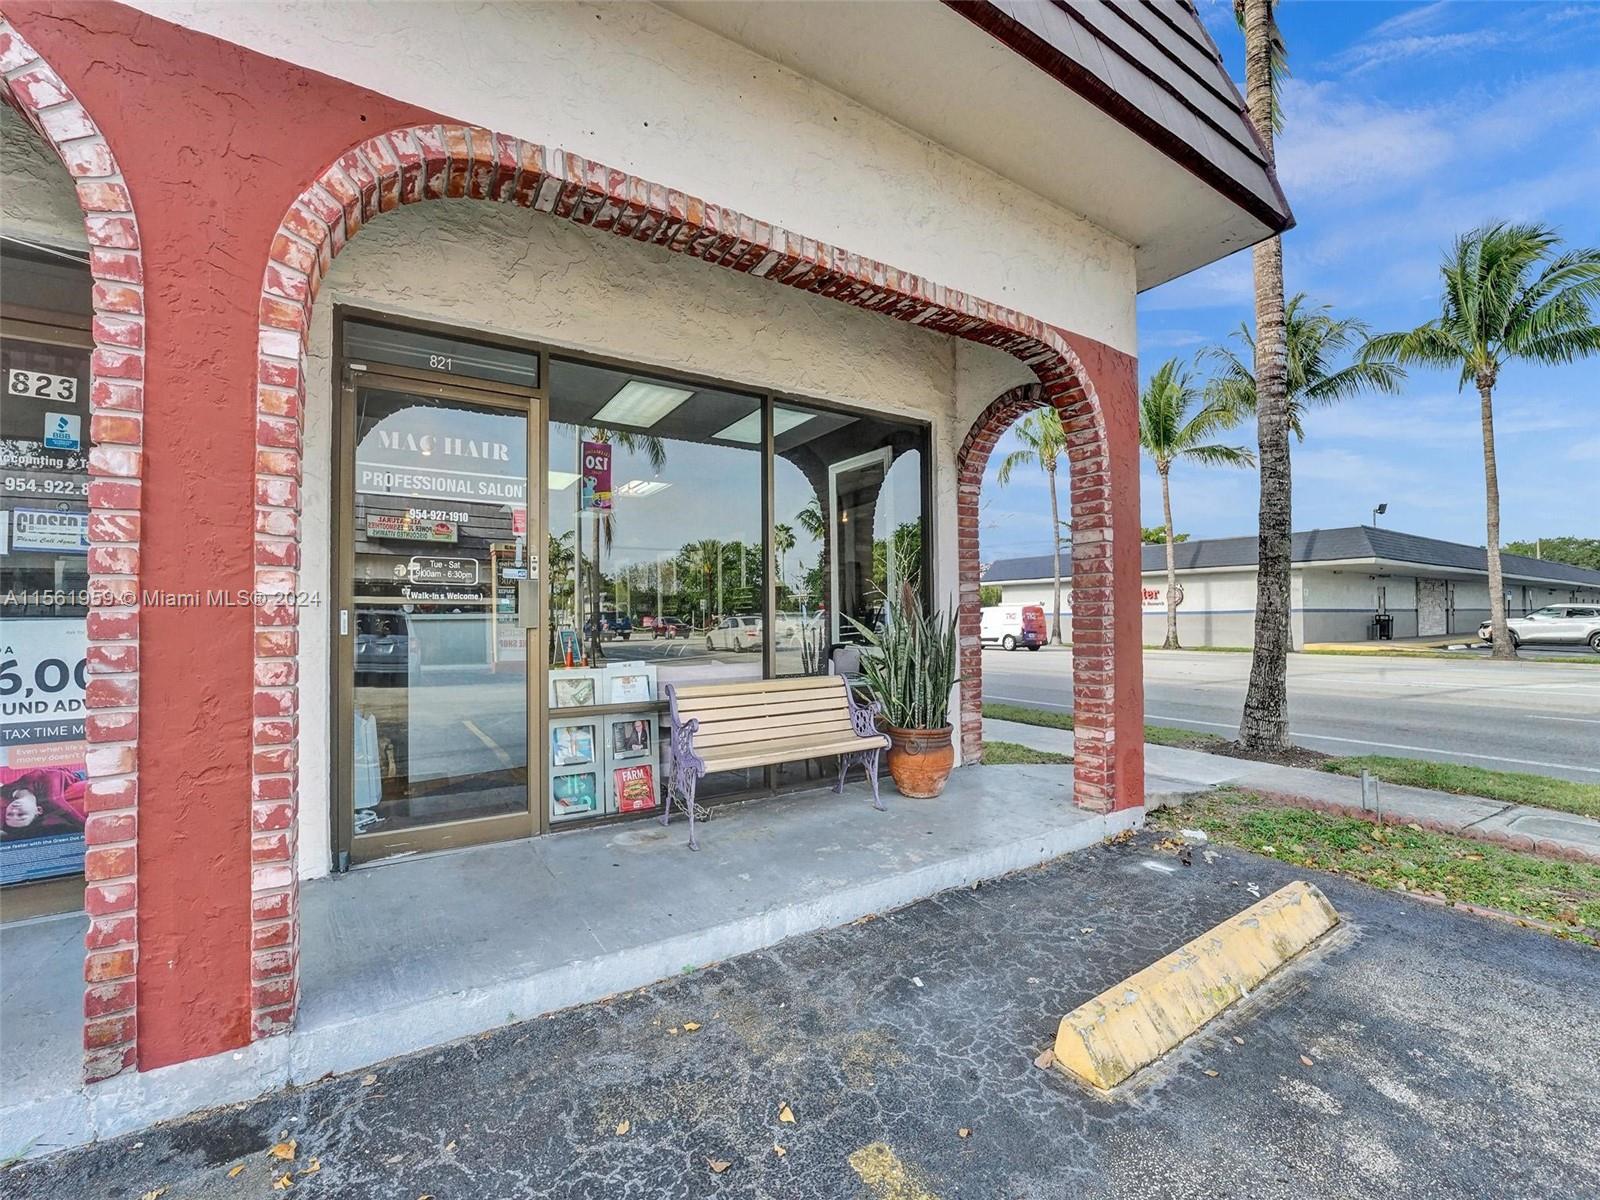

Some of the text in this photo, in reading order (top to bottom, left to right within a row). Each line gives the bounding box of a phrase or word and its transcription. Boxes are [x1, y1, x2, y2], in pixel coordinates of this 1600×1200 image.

[429, 354, 452, 371] 821
[10, 371, 75, 400] 823
[52, 432, 71, 440] BBB
[444, 436, 510, 461] HAIR
[80, 458, 89, 469] T
[362, 470, 523, 498] PROFESSIONAL SALON
[409, 508, 469, 523] 954-927-1910
[429, 559, 443, 568] Tue
[448, 560, 461, 569] Sat
[447, 570, 473, 580] 6:30pm
[0, 700, 49, 716] UND
[3, 724, 87, 740] TAX TIME M
[16, 748, 39, 756] Even
[39, 746, 64, 755] when
[16, 751, 81, 764] money doesn't
[622, 768, 646, 782] FARM
